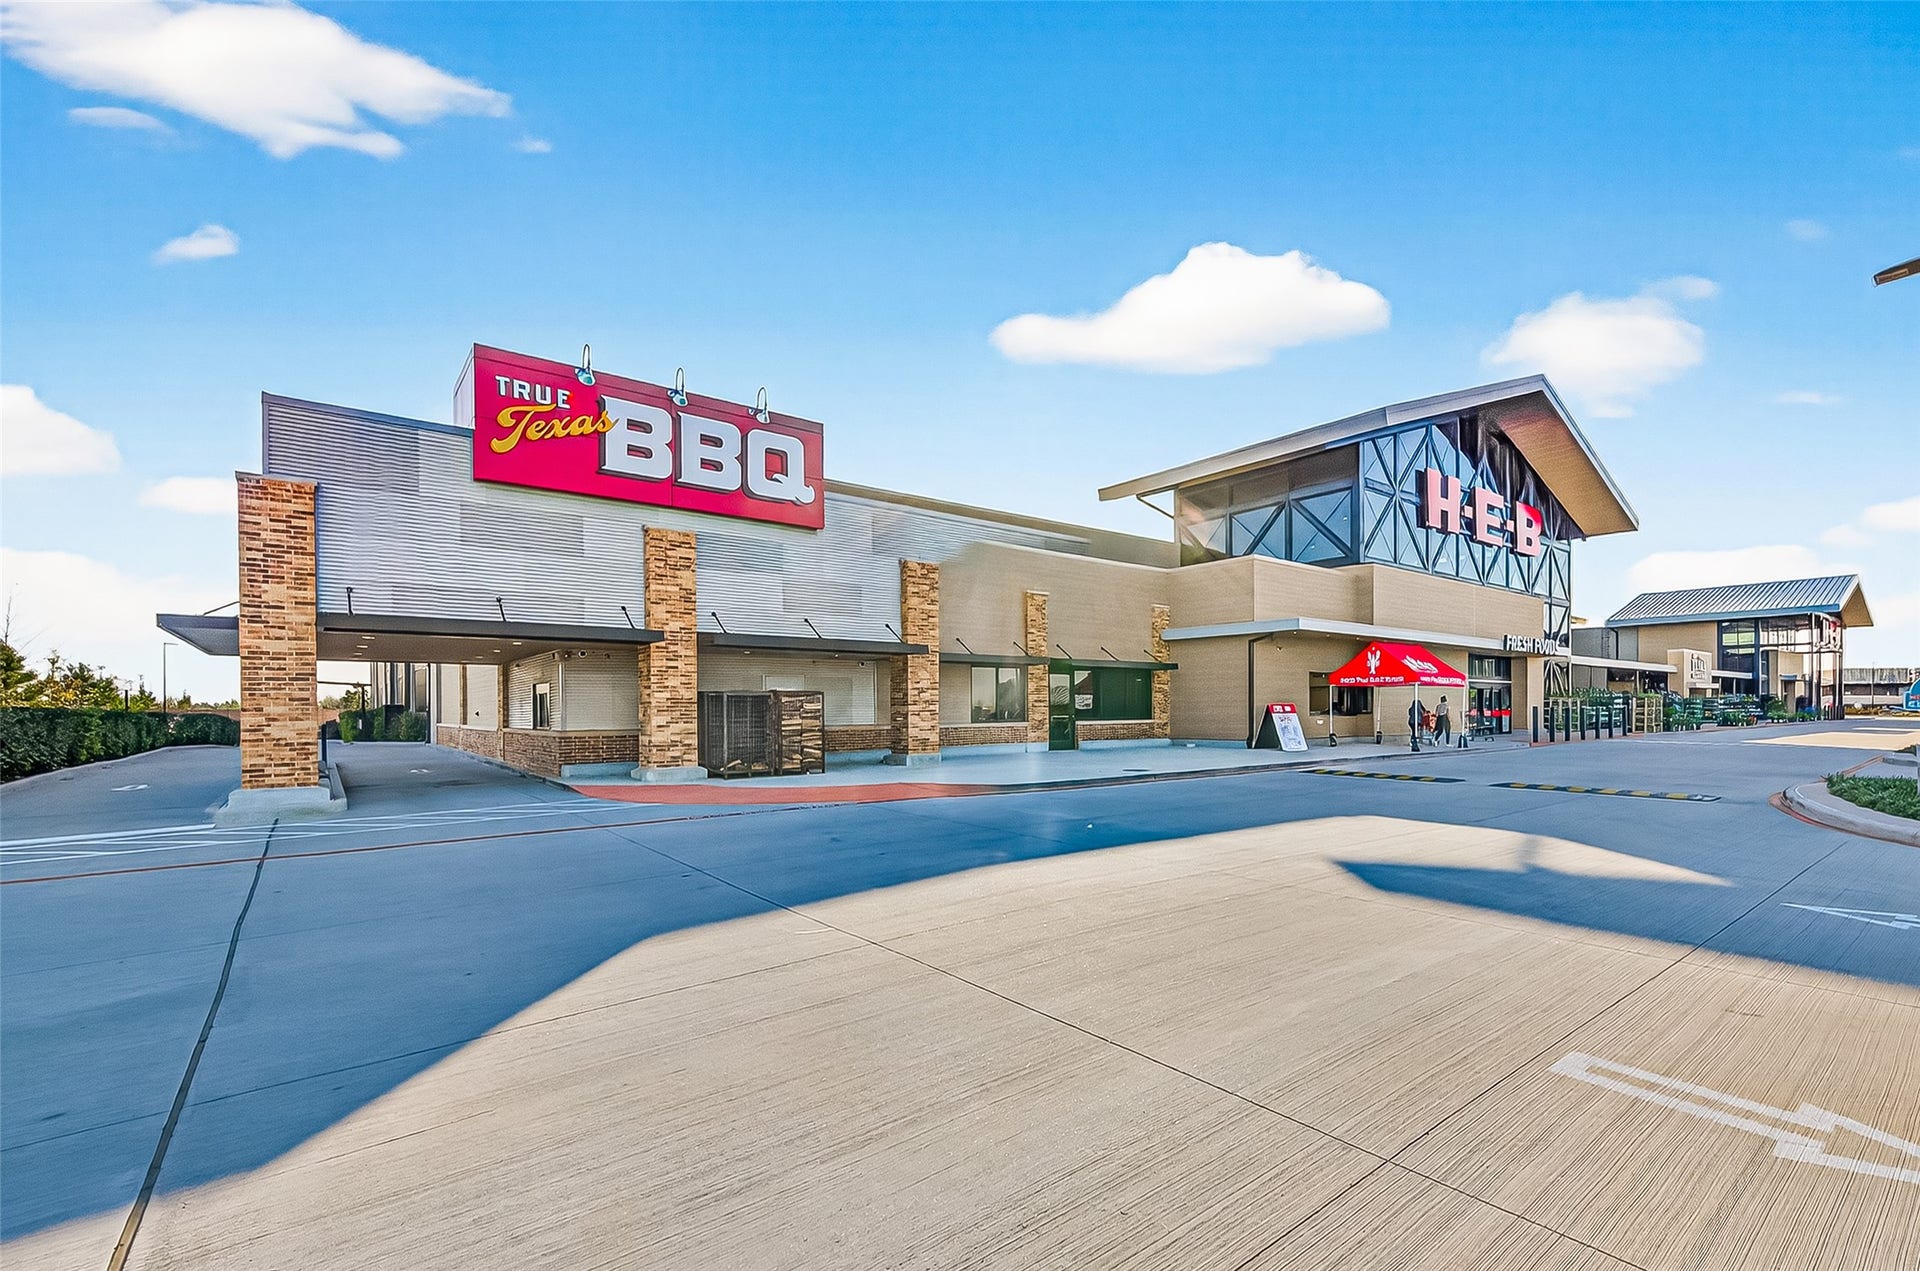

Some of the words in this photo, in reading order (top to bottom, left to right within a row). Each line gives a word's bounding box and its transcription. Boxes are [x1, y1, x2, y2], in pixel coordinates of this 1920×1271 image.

[495, 375, 571, 409] TRUE
[489, 403, 620, 454] Texas
[597, 394, 816, 505] BBQ
[1506, 633, 1534, 653] FRESH
